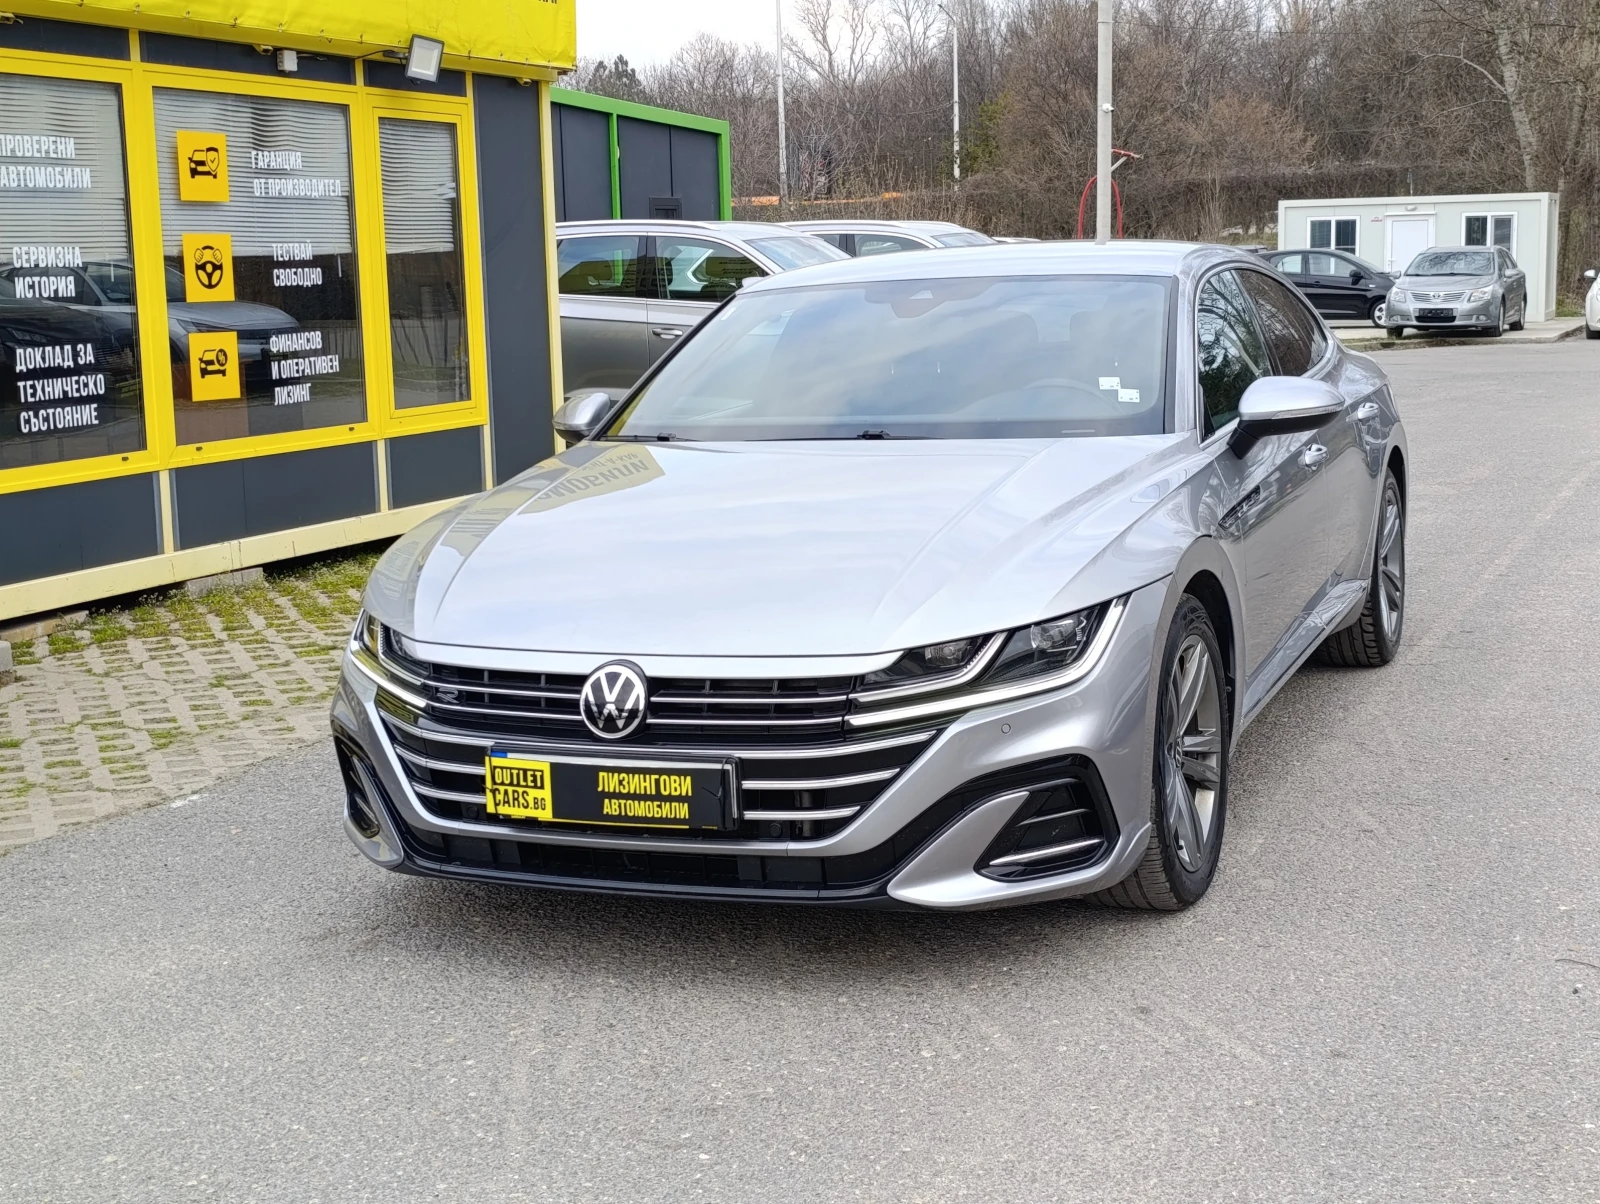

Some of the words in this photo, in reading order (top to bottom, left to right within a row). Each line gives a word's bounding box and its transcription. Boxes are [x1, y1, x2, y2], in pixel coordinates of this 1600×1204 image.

[0, 134, 76, 158] ПРОВЕРЕНИ
[251, 150, 302, 170] ГАРАНЦИЯ
[0, 165, 92, 189] АВТОМОБИЛИ
[253, 178, 266, 196] ОТ
[268, 178, 342, 198] ПРОИЗВОДИТЕЛ
[13, 246, 83, 268] СЕРВИЗНА
[271, 239, 313, 262] ТЕСТВАЙ
[15, 275, 76, 299] ИСТОРИЯ
[273, 267, 322, 288] СВОБОДНО
[269, 330, 323, 353] ФИНАНСОВ
[15, 344, 74, 374] ДОКЛАД
[77, 342, 95, 365] ЗА
[271, 360, 280, 380] И
[280, 354, 340, 379] ОПЕРАТИВЕН
[17, 373, 105, 403] ТЕХНИЧЕСКО
[274, 383, 312, 406] ЛИЗИНГ
[19, 404, 99, 434] СЪСТОЯНИЕ
[494, 767, 543, 788] OUTLET
[597, 771, 692, 797] ЛИЗИНГОВИ
[493, 787, 546, 811] CARS.BG
[603, 798, 690, 820] АВТОМОБИЛИ
